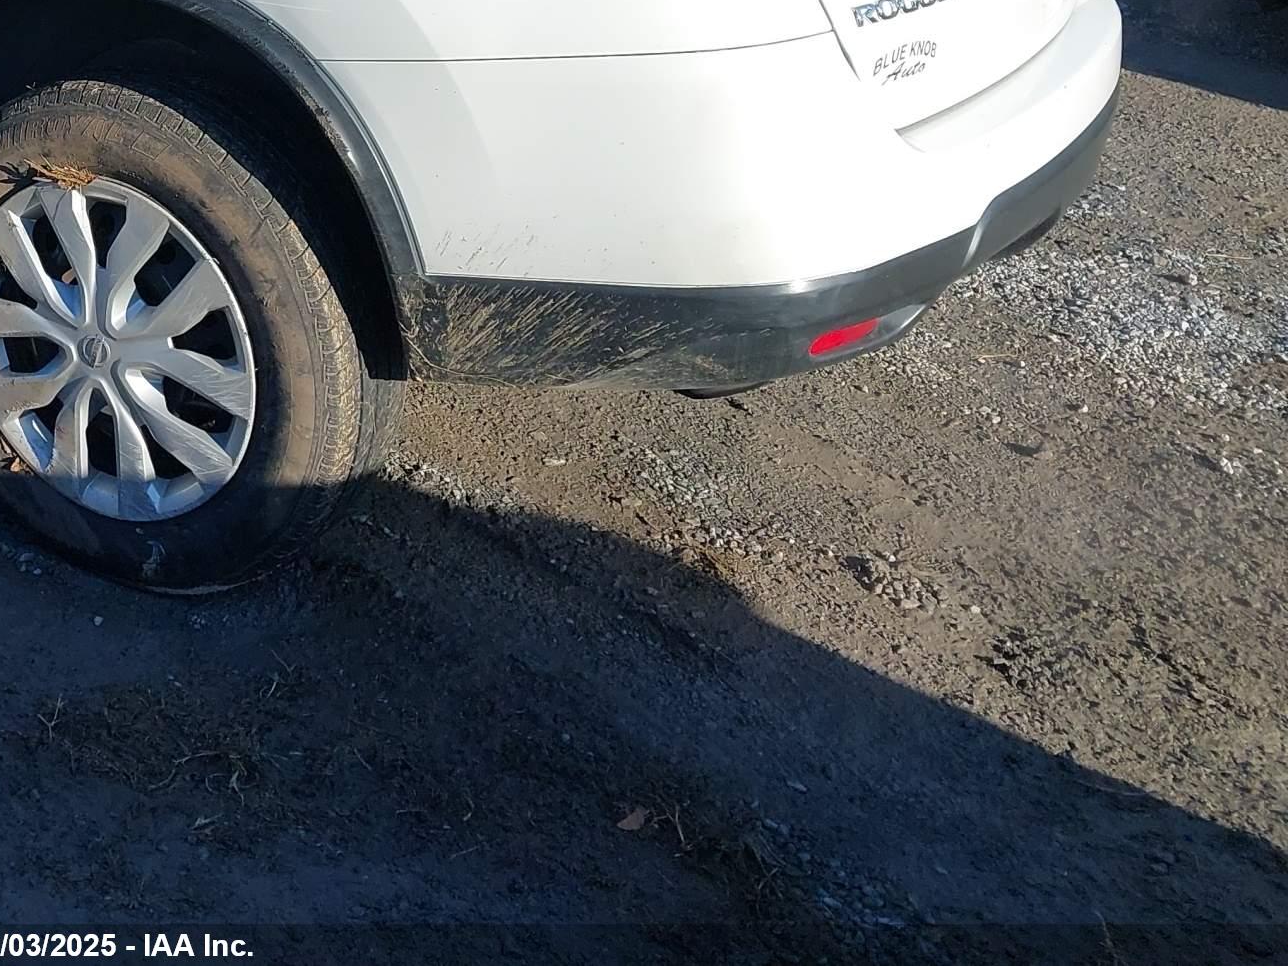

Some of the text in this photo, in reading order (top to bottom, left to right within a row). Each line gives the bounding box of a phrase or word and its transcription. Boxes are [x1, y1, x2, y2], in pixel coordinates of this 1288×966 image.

[873, 40, 937, 77] BLUE KNOB
[881, 61, 926, 86] Auto
